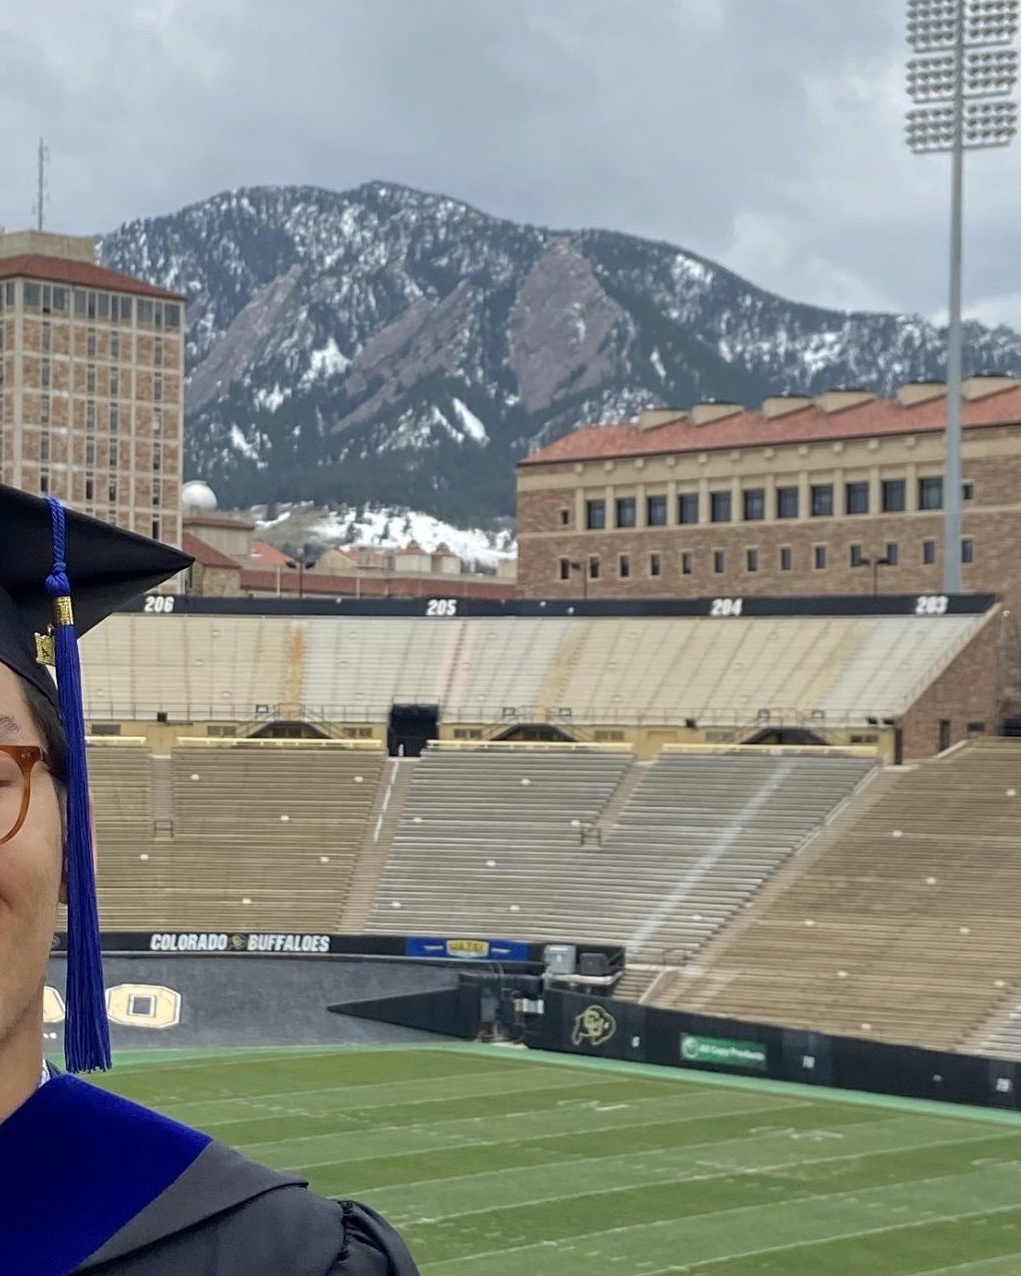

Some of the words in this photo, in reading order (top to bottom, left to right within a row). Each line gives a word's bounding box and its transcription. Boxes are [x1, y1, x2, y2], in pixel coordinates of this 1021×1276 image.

[144, 596, 176, 614] 206
[426, 599, 458, 616] 205
[710, 598, 743, 617] 204
[150, 933, 229, 951] COLORADO
[246, 934, 331, 953] BUFFALOES
